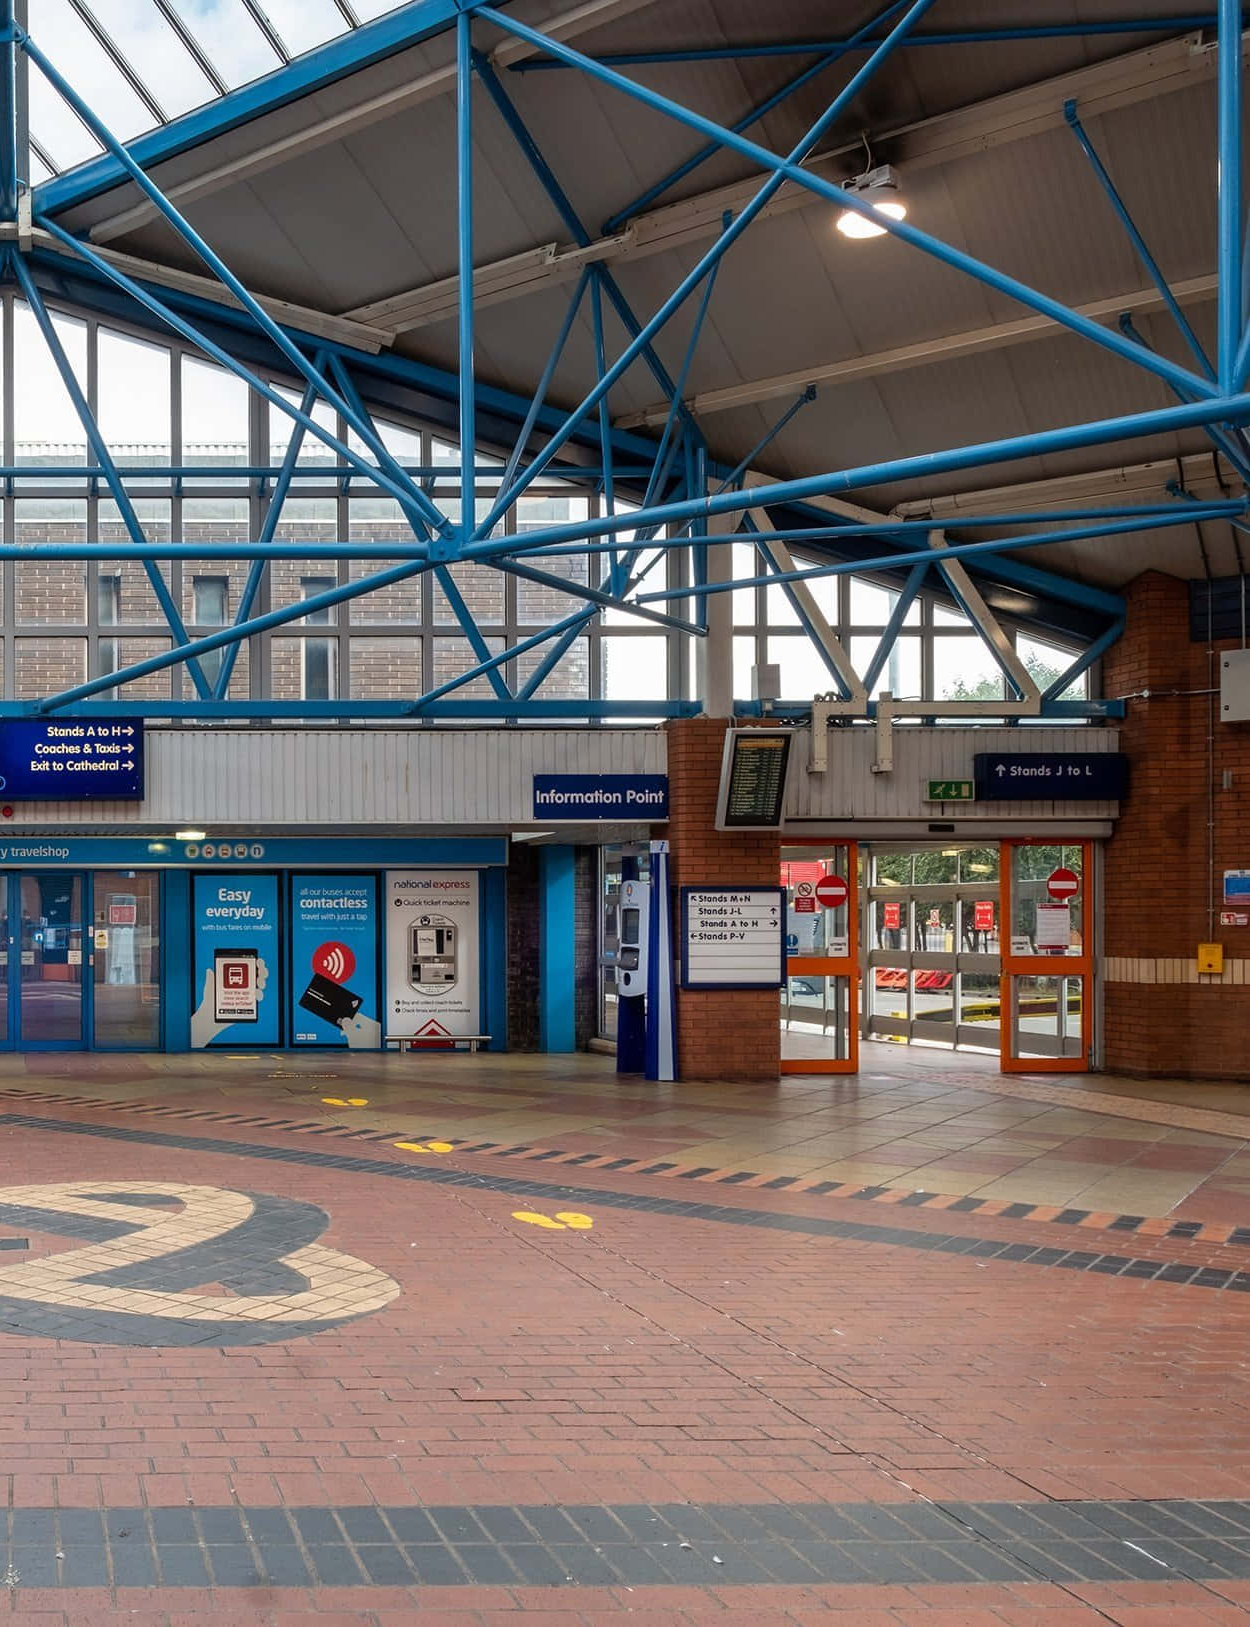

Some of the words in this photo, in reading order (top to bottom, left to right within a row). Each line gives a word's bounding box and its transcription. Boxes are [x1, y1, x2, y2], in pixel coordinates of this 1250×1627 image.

[47, 726, 84, 736] Stands
[86, 726, 96, 736] A
[98, 726, 110, 736] to
[112, 726, 121, 736] H
[34, 743, 80, 754] Coaches
[82, 744, 92, 754] &
[94, 744, 121, 754] Taxis
[30, 760, 50, 771] Exit
[52, 761, 64, 771] to
[66, 760, 119, 771] Cathedral
[1010, 764, 1051, 776] Stands
[1056, 766, 1062, 776] J
[1067, 766, 1080, 776] to
[1085, 766, 1092, 776] L
[536, 790, 622, 804] Information
[626, 790, 664, 804] Point
[11, 845, 70, 859] travelshop
[394, 880, 432, 888] national
[432, 880, 470, 891] express
[218, 888, 251, 904] Easy
[300, 888, 308, 896] all
[322, 888, 343, 896] buses
[344, 889, 367, 898] accept
[300, 897, 368, 908] contactless
[206, 905, 265, 920] everyday
[336, 914, 350, 922] just
[356, 914, 367, 922] tap
[700, 920, 728, 928] Stands
[730, 920, 737, 928] A
[740, 920, 748, 928] to
[752, 920, 758, 928] H
[698, 932, 728, 940] Stands
